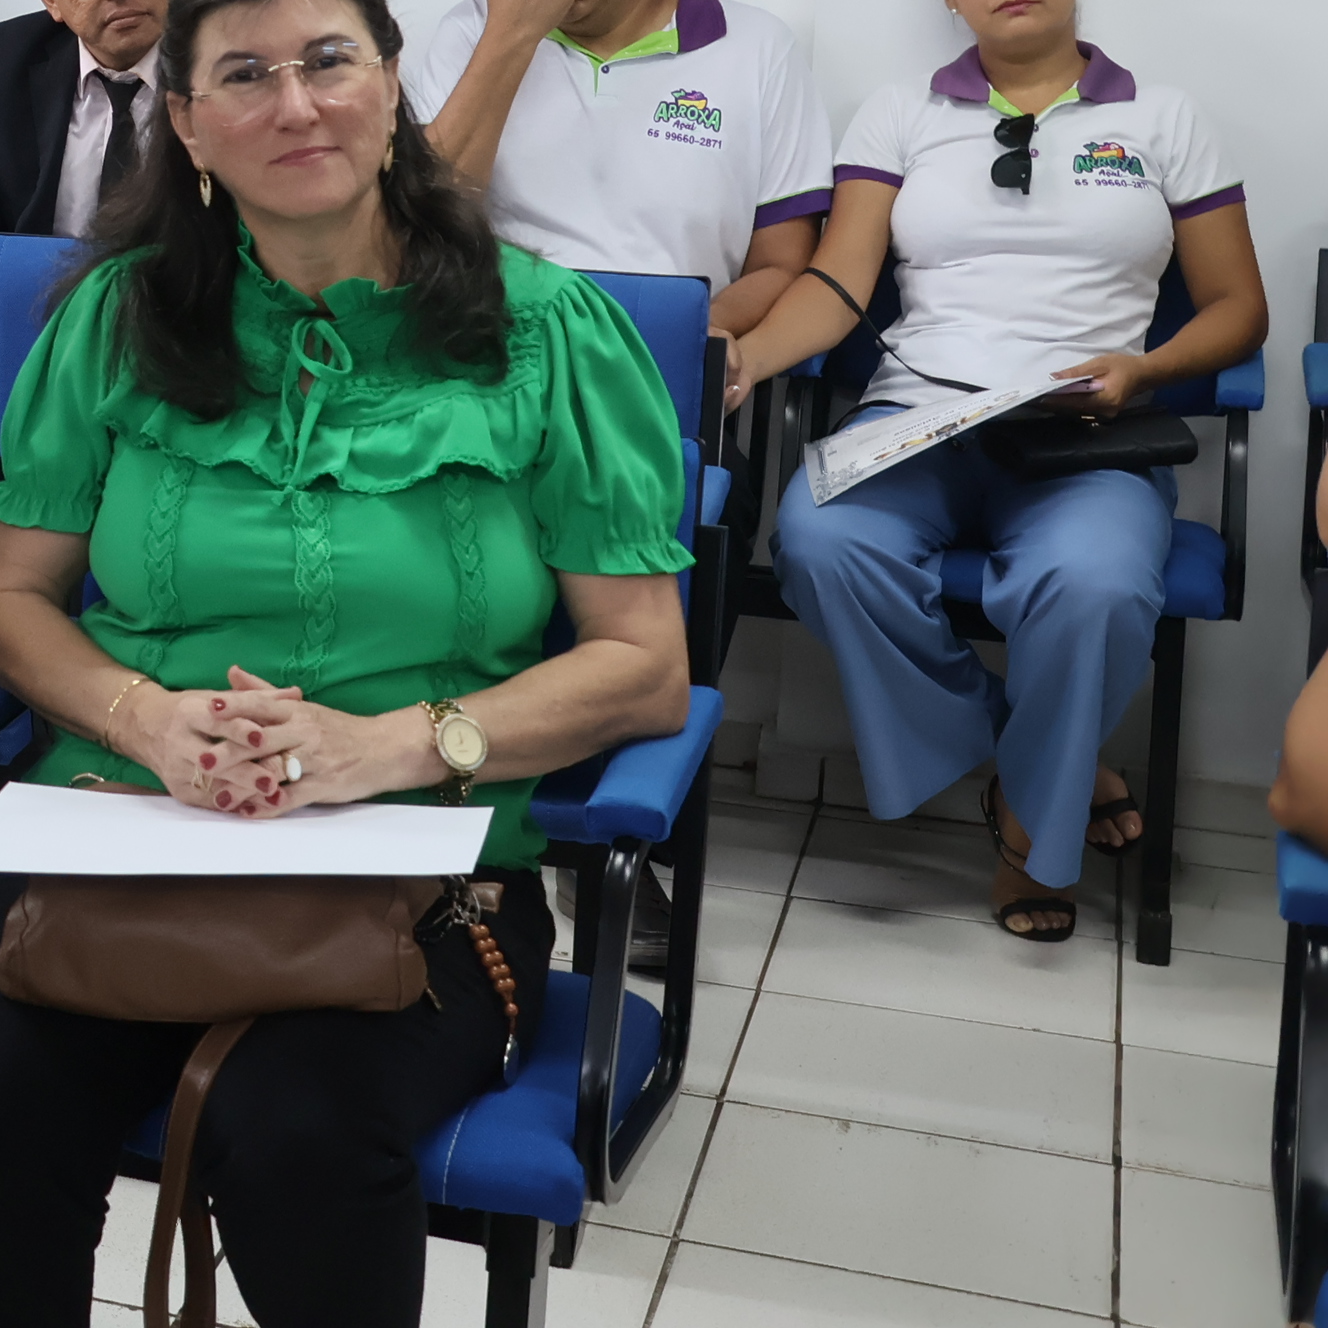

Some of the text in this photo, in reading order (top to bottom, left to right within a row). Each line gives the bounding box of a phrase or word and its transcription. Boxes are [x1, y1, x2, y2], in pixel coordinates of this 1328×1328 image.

[653, 101, 722, 133] ARROXA
[647, 128, 722, 149] 65 99660-2871
[1073, 154, 1145, 178] ARROXA
